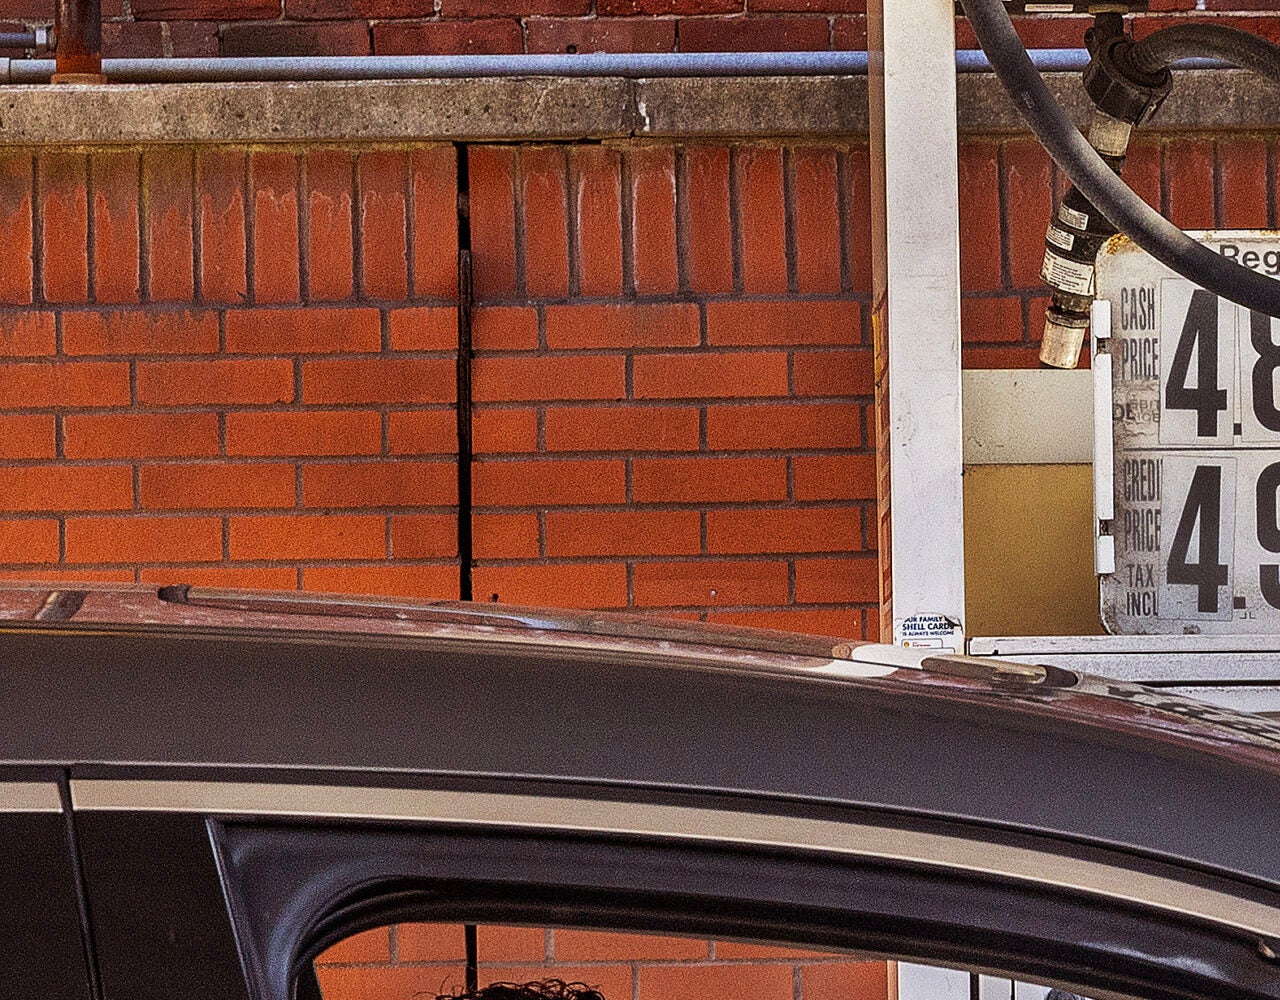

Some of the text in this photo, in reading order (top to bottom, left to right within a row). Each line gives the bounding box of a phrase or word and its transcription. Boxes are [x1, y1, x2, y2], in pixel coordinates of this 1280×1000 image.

[1121, 287, 1155, 330] CASH
[1122, 338, 1159, 380] PRICE
[1124, 459, 1163, 501] CREDI
[1125, 509, 1161, 551] PRICE
[1125, 564, 1155, 588] TAX
